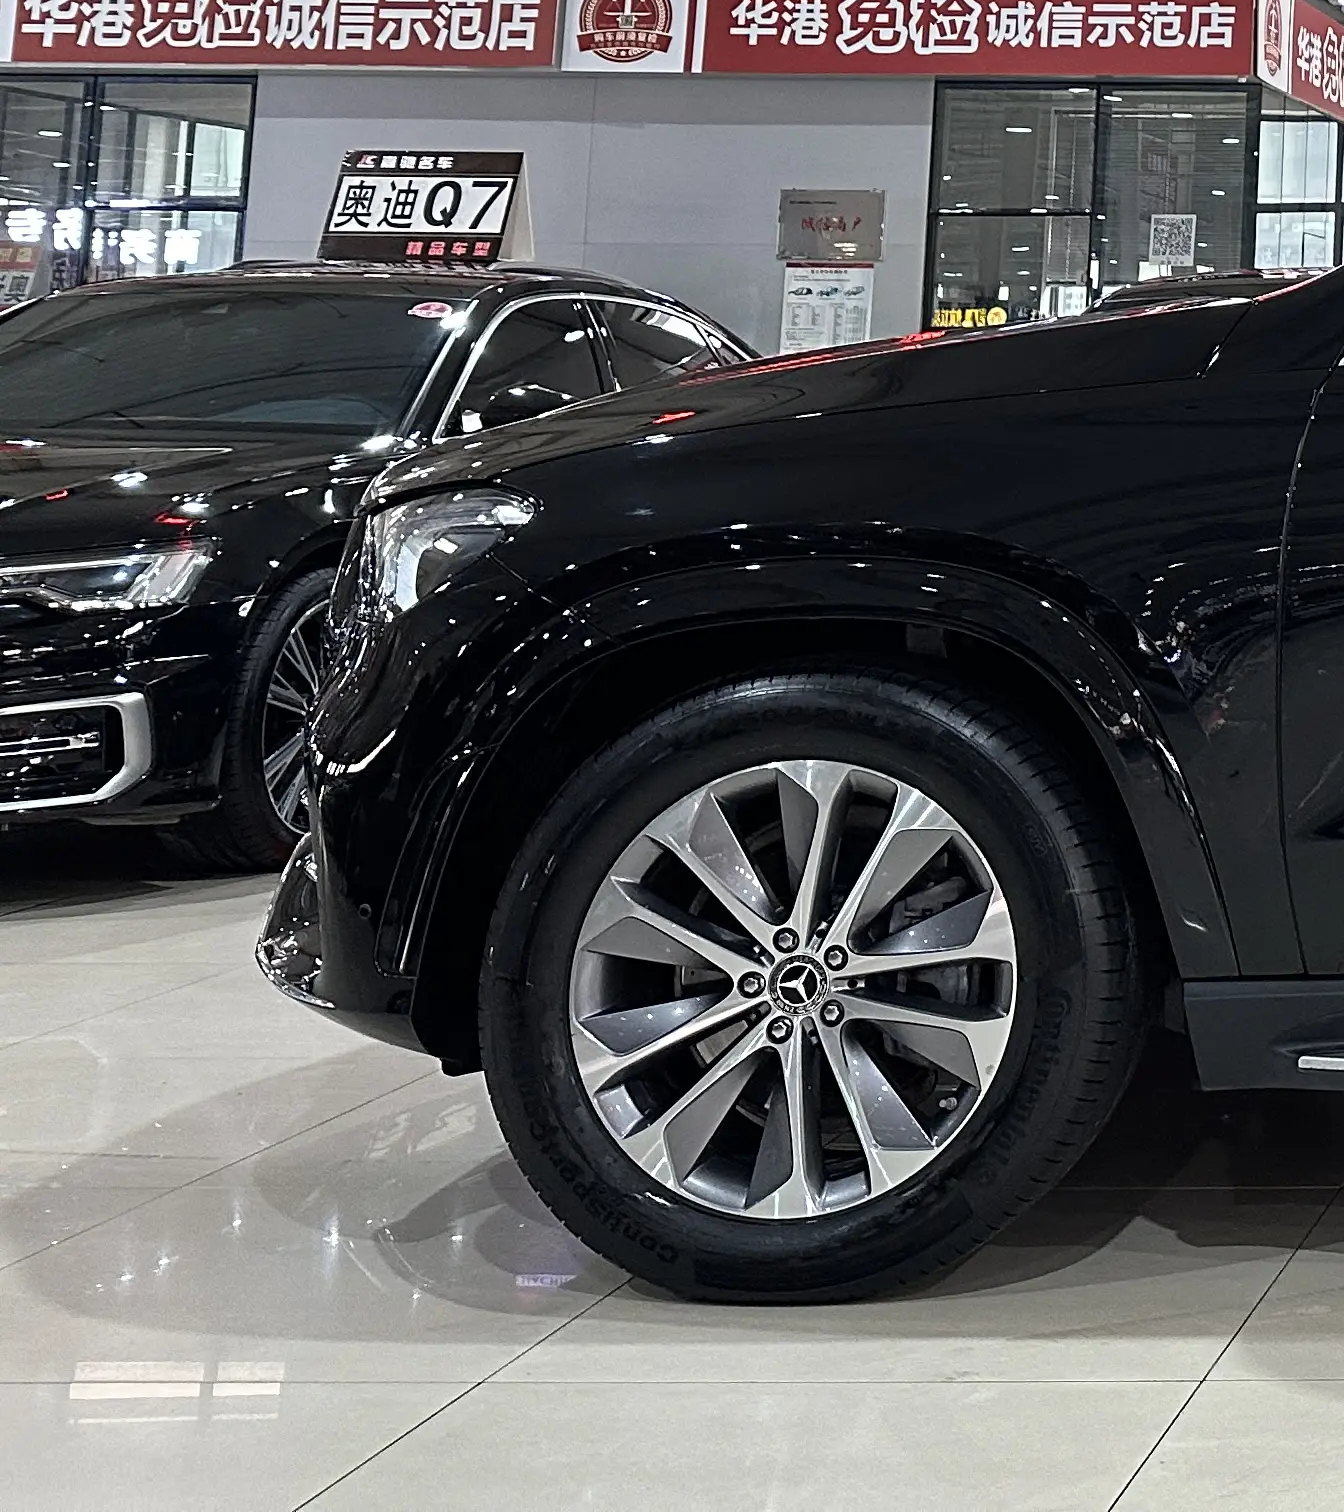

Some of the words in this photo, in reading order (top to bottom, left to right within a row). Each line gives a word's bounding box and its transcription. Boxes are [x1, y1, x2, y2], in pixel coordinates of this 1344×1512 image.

[334, 179, 508, 230] 奥迪Q7
[405, 240, 491, 257] 精品车型
